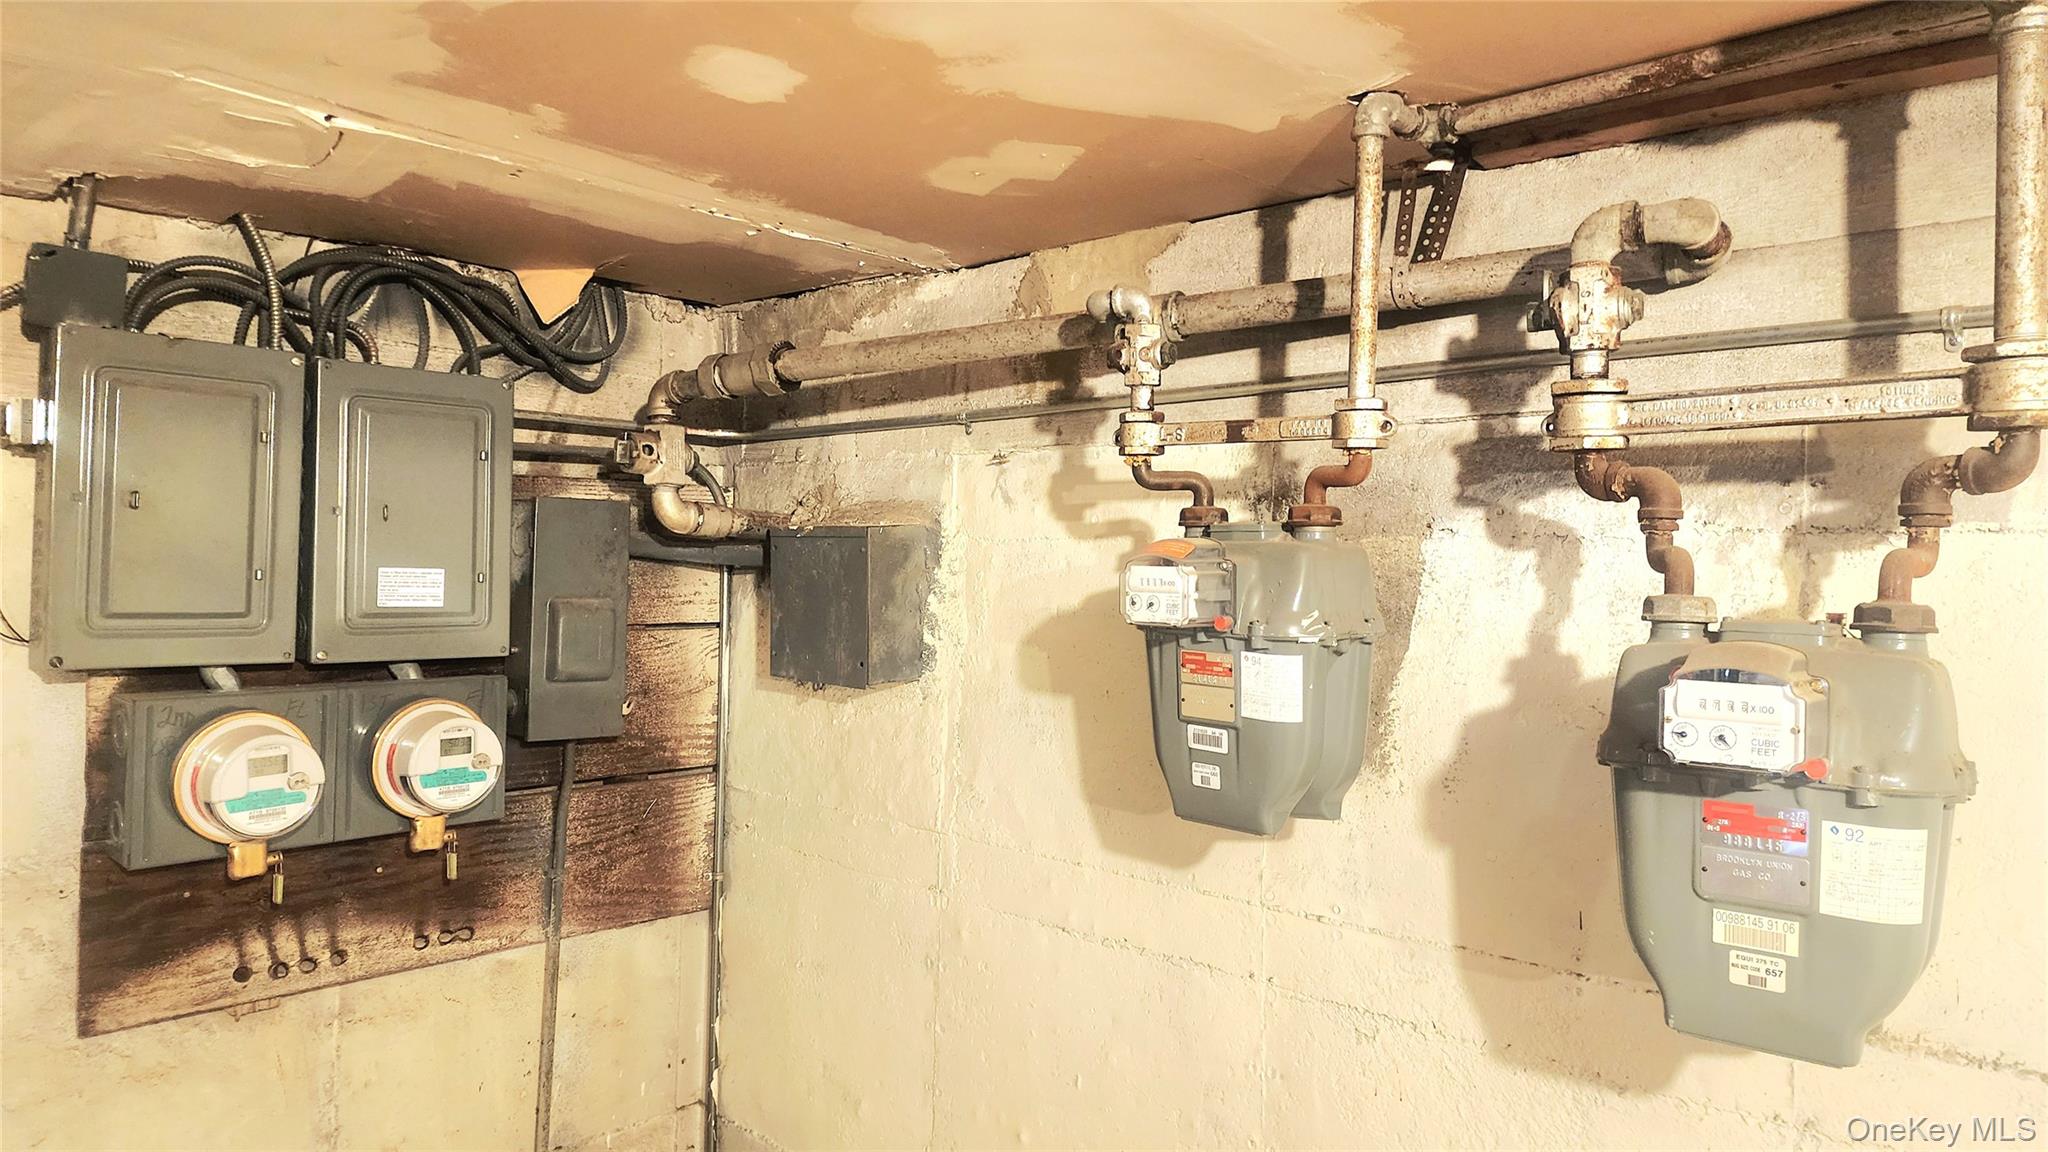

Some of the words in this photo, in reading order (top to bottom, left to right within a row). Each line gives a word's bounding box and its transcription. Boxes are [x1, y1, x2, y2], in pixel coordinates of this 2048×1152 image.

[1759, 706, 1775, 714] 100
[1751, 738, 1780, 748] CUBIC
[1751, 748, 1777, 757] FEET
[1845, 827, 1864, 843] 92
[1716, 853, 1763, 867] BROOKLYN
[1766, 861, 1793, 871] UNION
[1732, 868, 1752, 878] GAS
[1716, 911, 1764, 929] 00988145
[1767, 920, 1779, 931] 91
[1782, 922, 1796, 934] 06
[1765, 968, 1783, 978] 657
